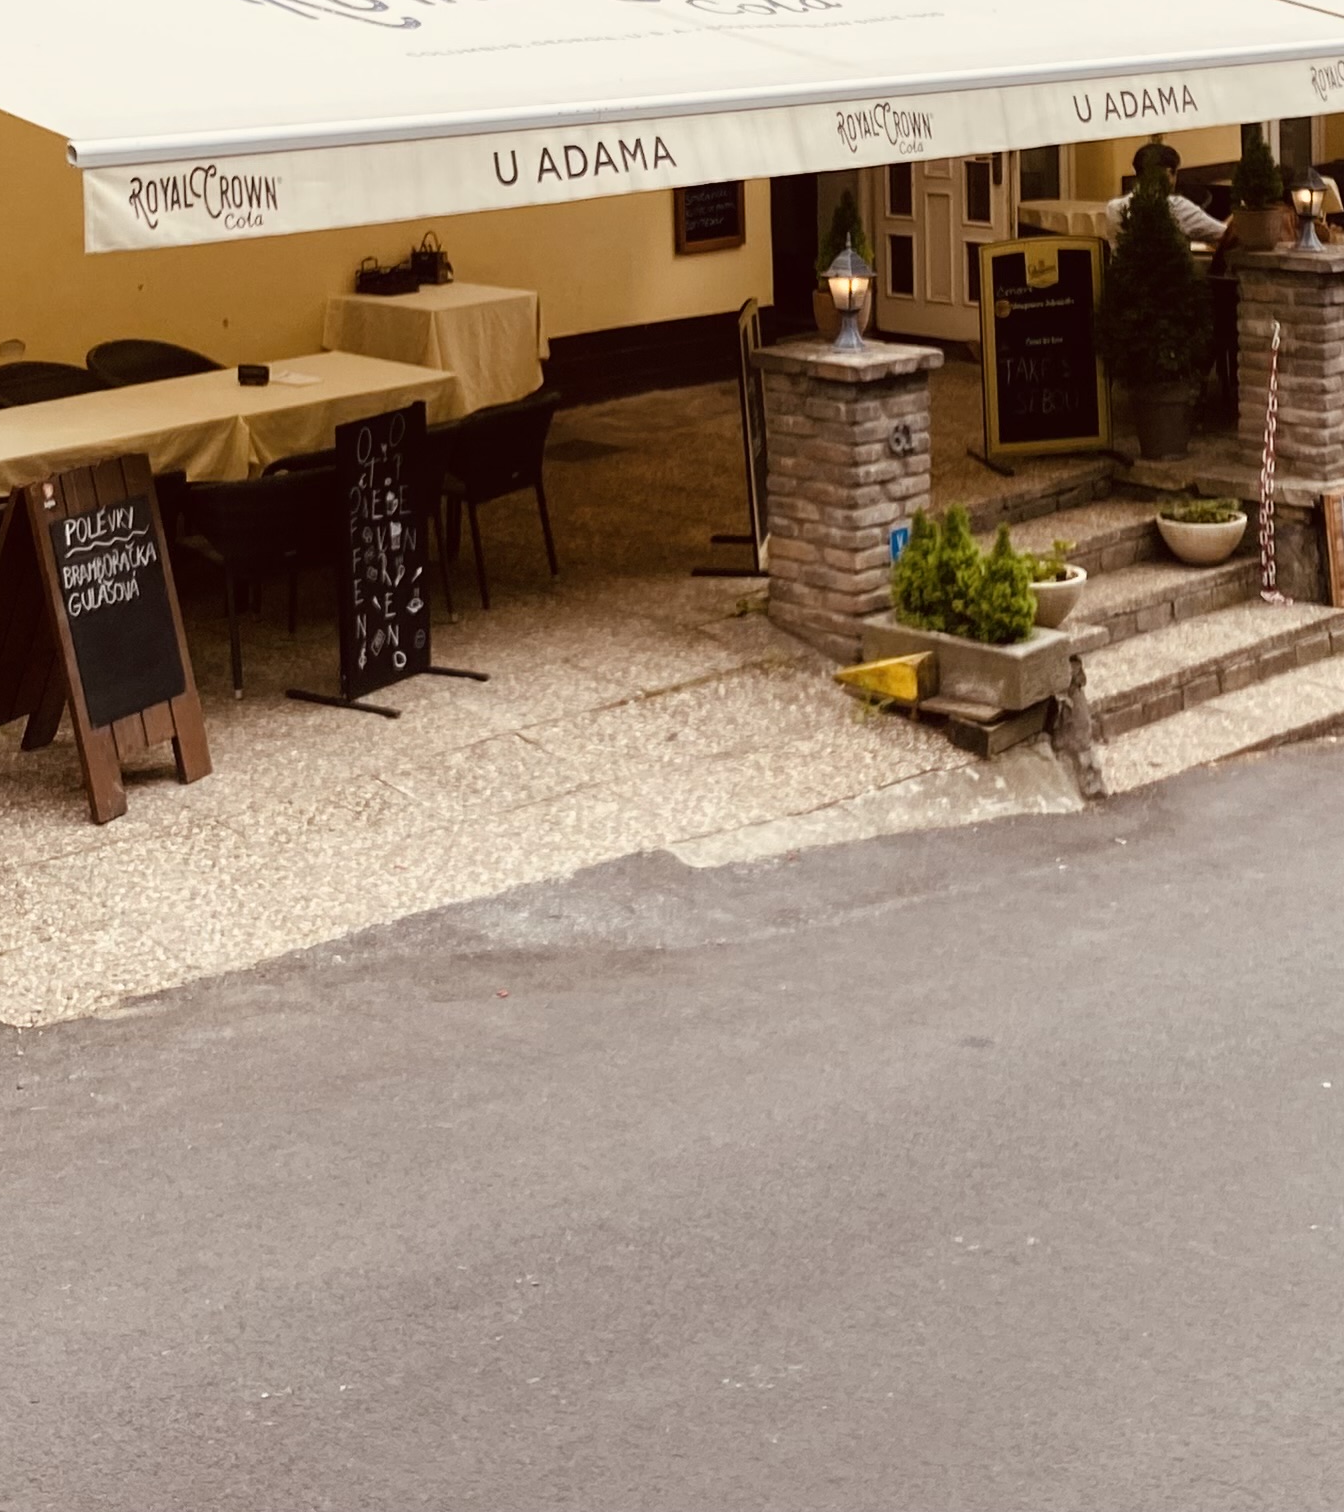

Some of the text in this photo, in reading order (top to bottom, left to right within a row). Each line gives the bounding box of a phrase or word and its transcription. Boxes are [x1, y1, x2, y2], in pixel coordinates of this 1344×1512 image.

[1310, 64, 1344, 102] ROYAL
[1072, 84, 1199, 123] U ADAMA
[836, 102, 933, 153] ROYAL CROWN
[493, 135, 678, 187] U ADAMA
[899, 140, 924, 155] Cola
[129, 164, 279, 230] ROYAL CROWN
[224, 211, 264, 230] Cola
